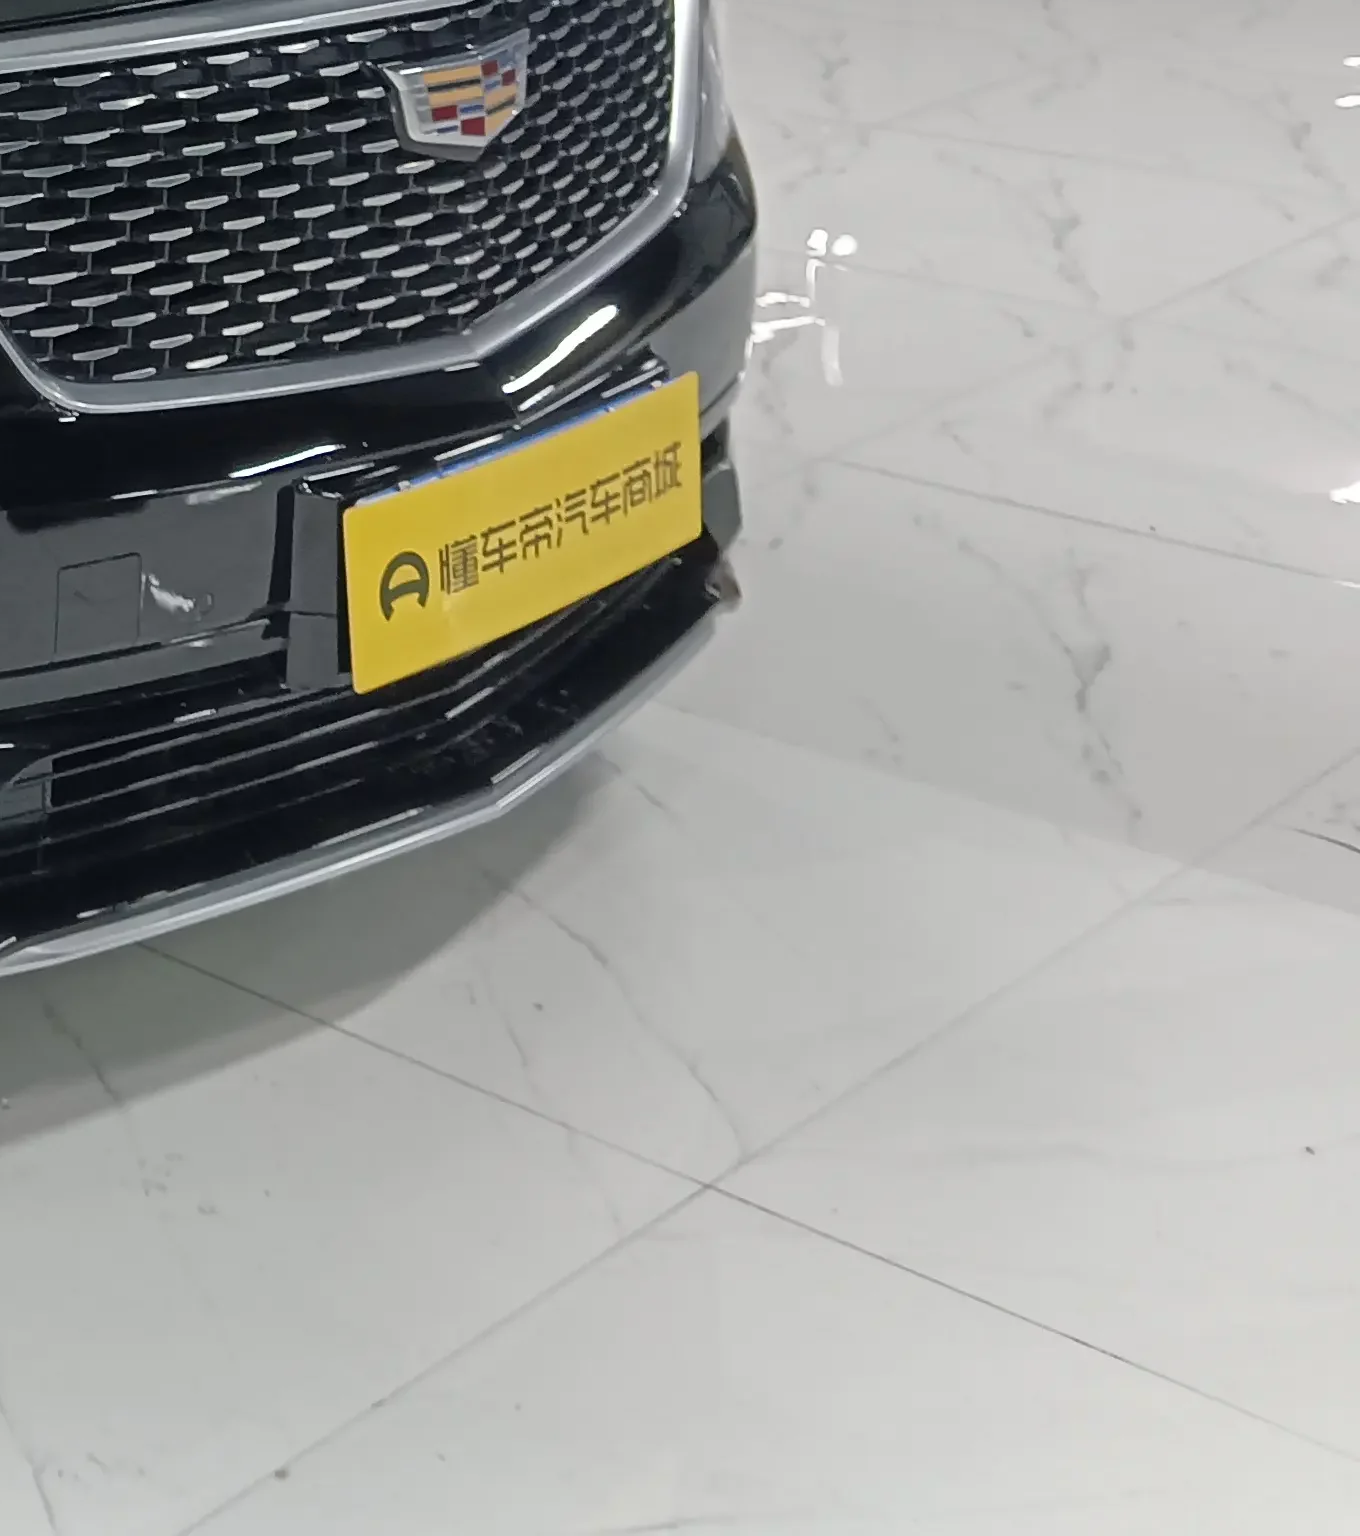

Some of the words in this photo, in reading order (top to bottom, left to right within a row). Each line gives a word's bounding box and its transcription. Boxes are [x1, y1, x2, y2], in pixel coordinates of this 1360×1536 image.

[438, 441, 683, 594] 懂车帝汽车商城
